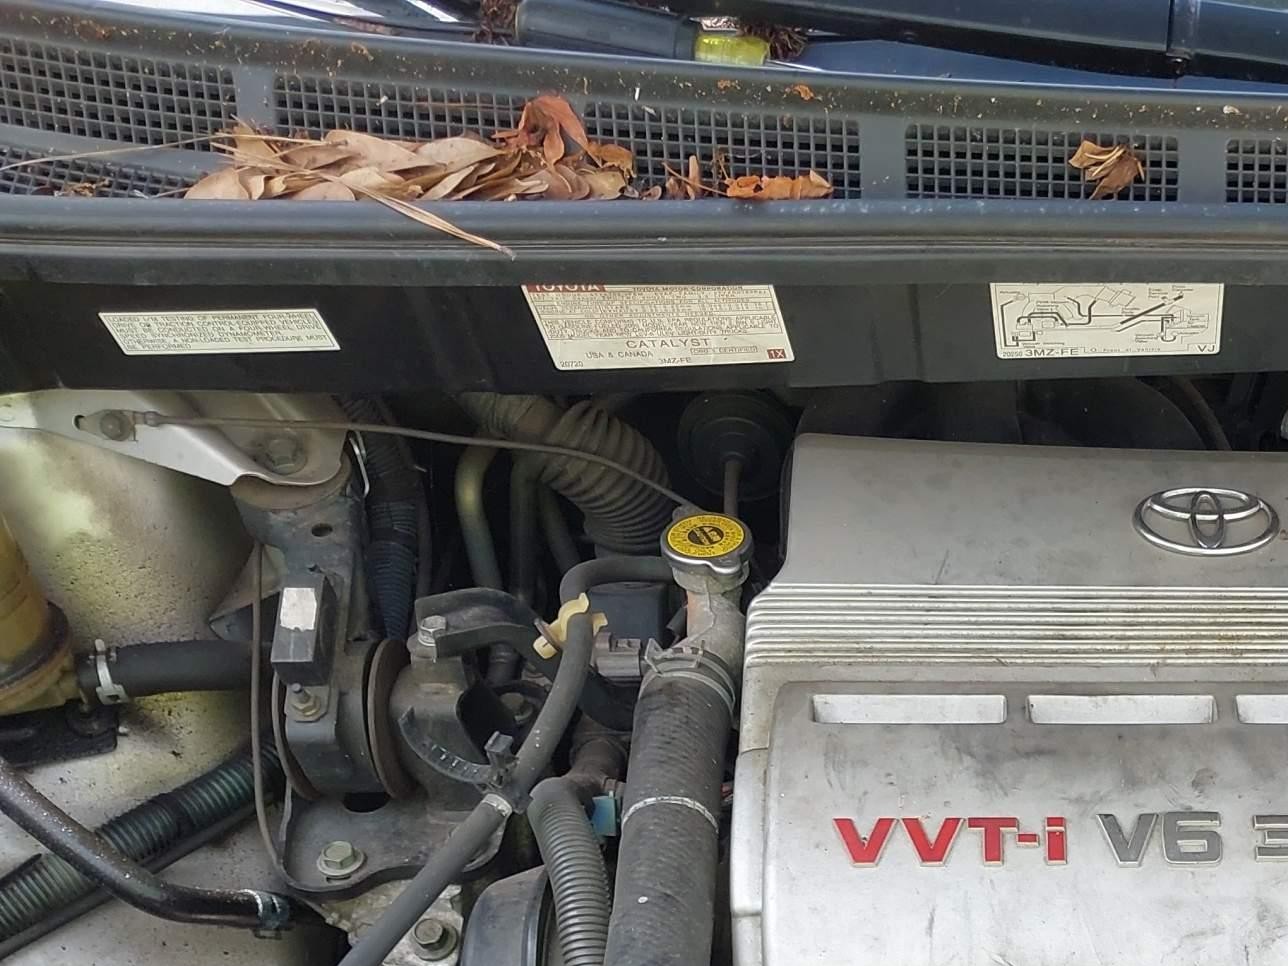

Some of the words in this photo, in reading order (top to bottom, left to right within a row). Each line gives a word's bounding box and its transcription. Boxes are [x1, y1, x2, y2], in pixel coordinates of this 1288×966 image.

[626, 338, 711, 349] CATALYST
[585, 351, 604, 359] USA
[1025, 348, 1079, 357] 3MZ-FE
[833, 816, 1067, 867] VVT-i
[1096, 811, 1223, 867] V6
